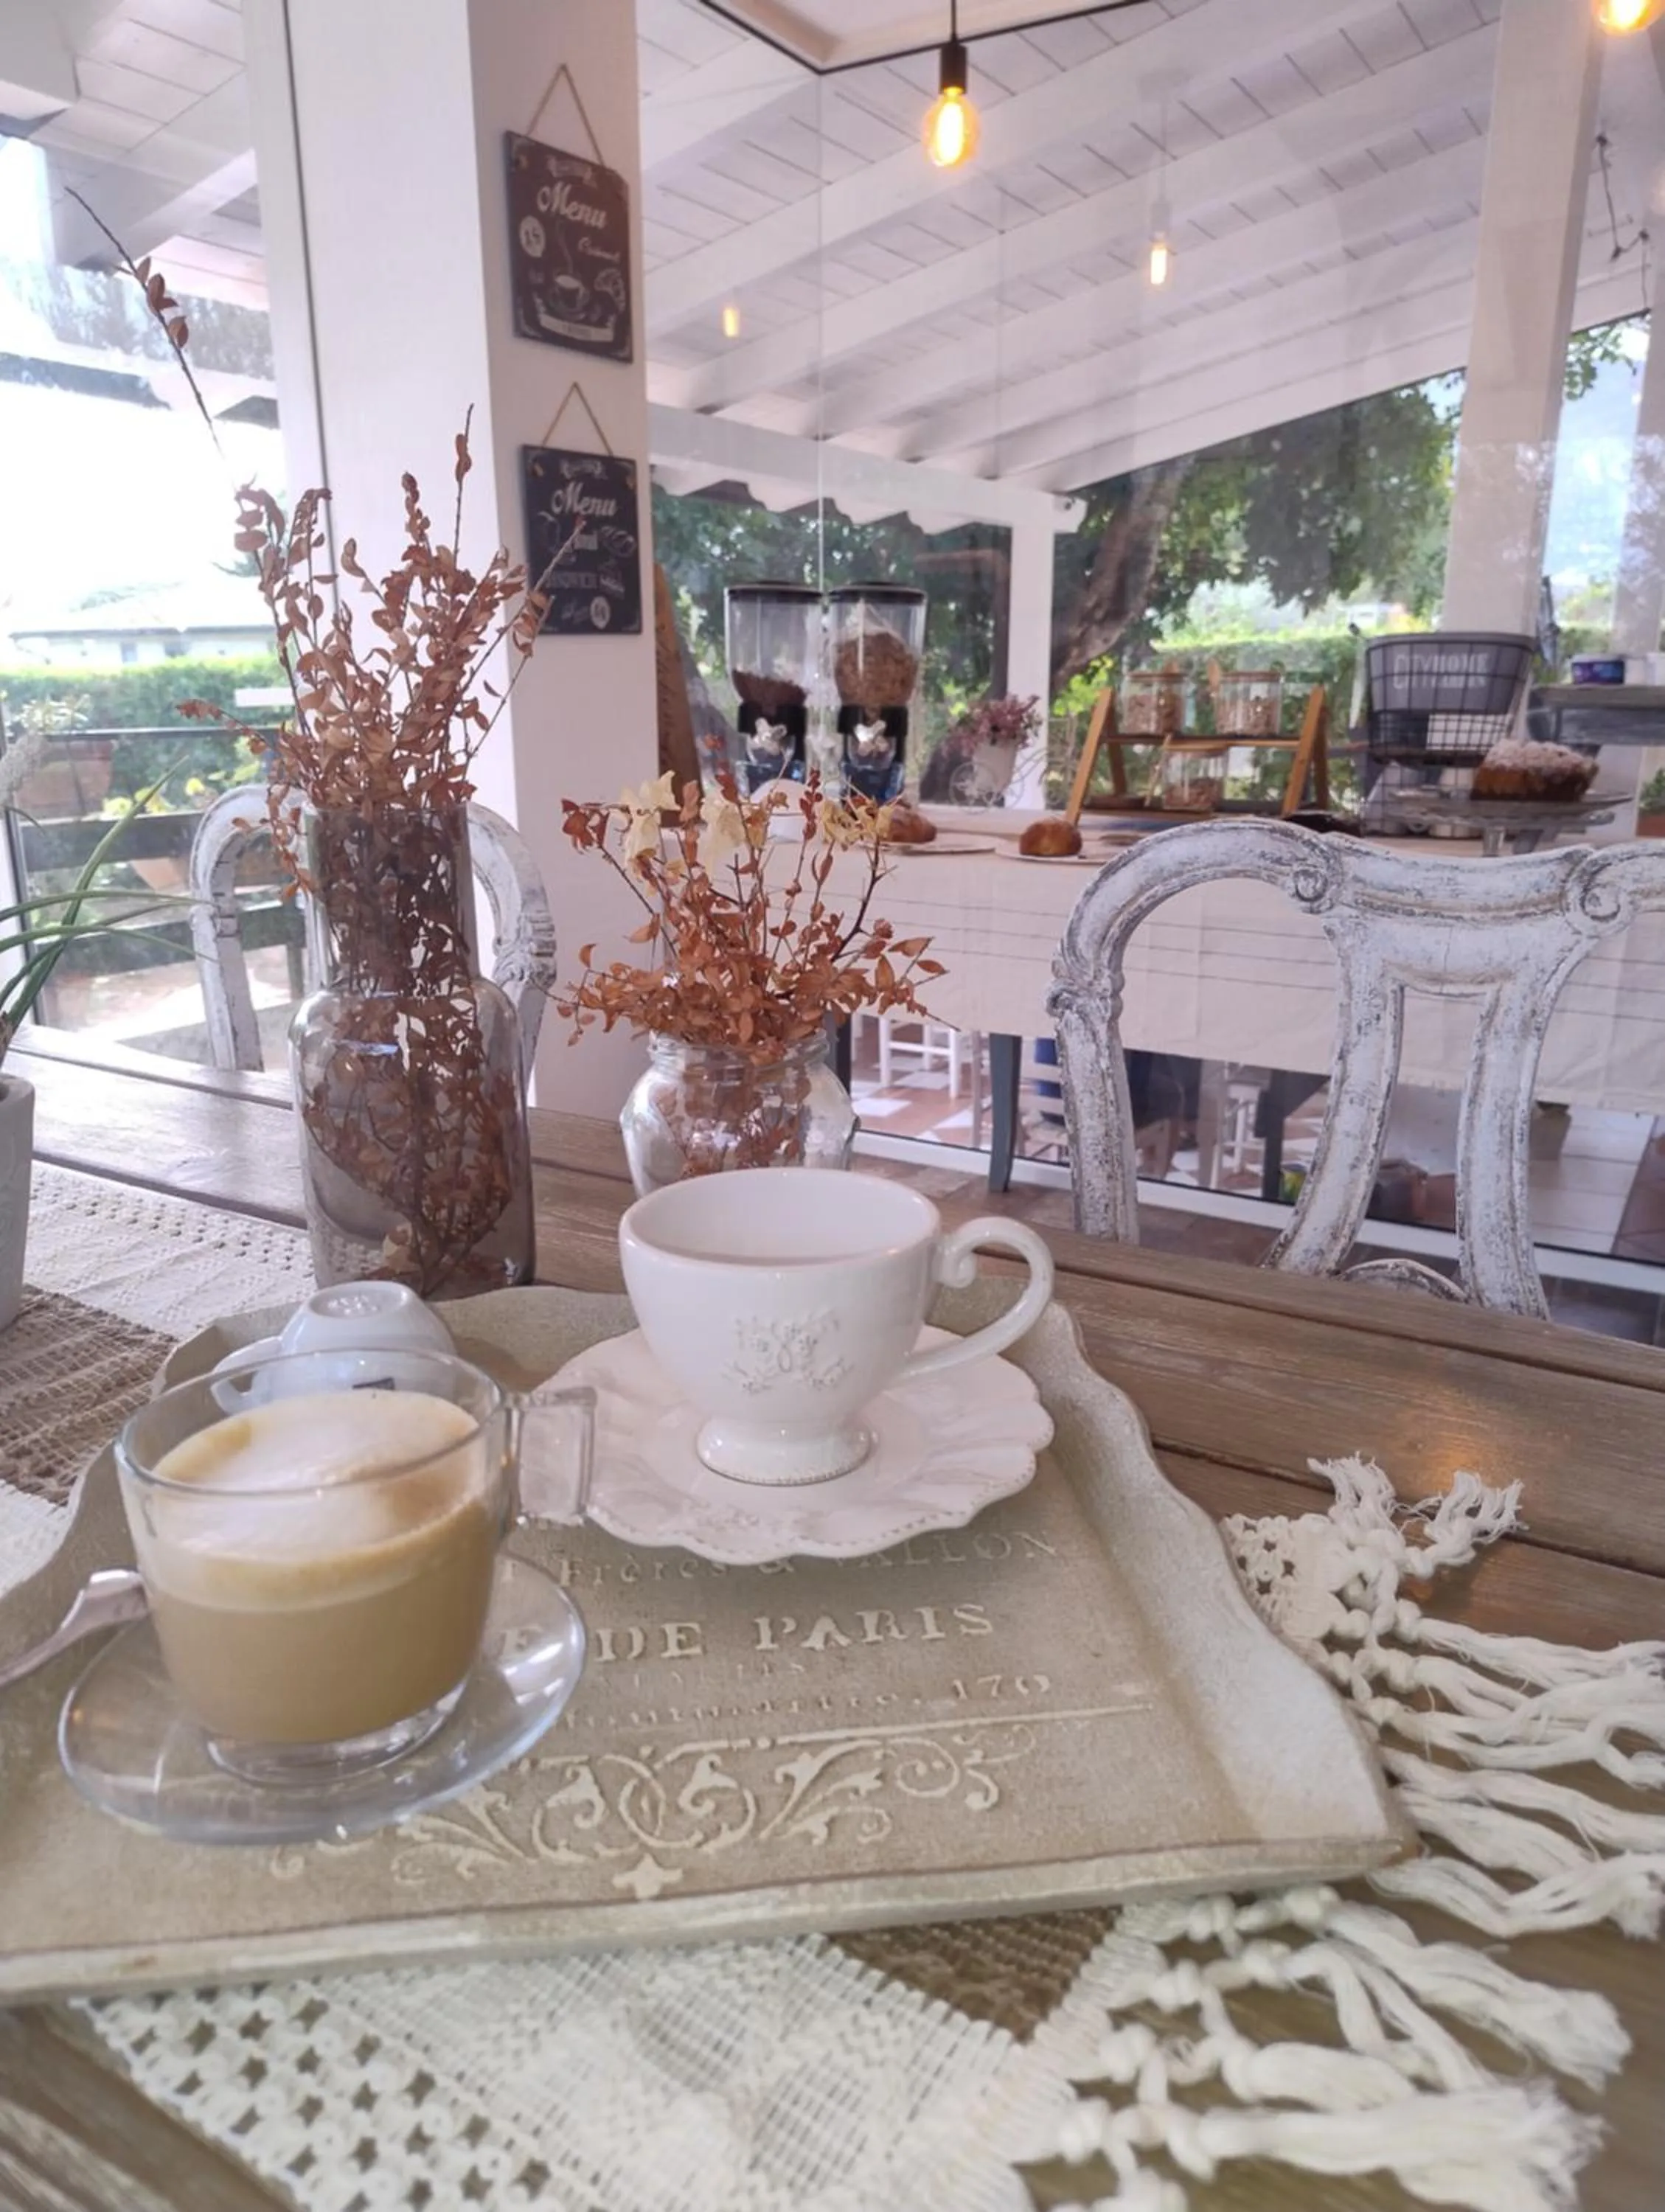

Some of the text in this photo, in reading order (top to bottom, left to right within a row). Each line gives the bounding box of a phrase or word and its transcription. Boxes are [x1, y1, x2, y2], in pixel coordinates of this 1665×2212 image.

[536, 181, 607, 230] Menu
[552, 481, 618, 517] Menu
[592, 1622, 703, 1662] DE
[754, 1604, 994, 1652] PARIS
